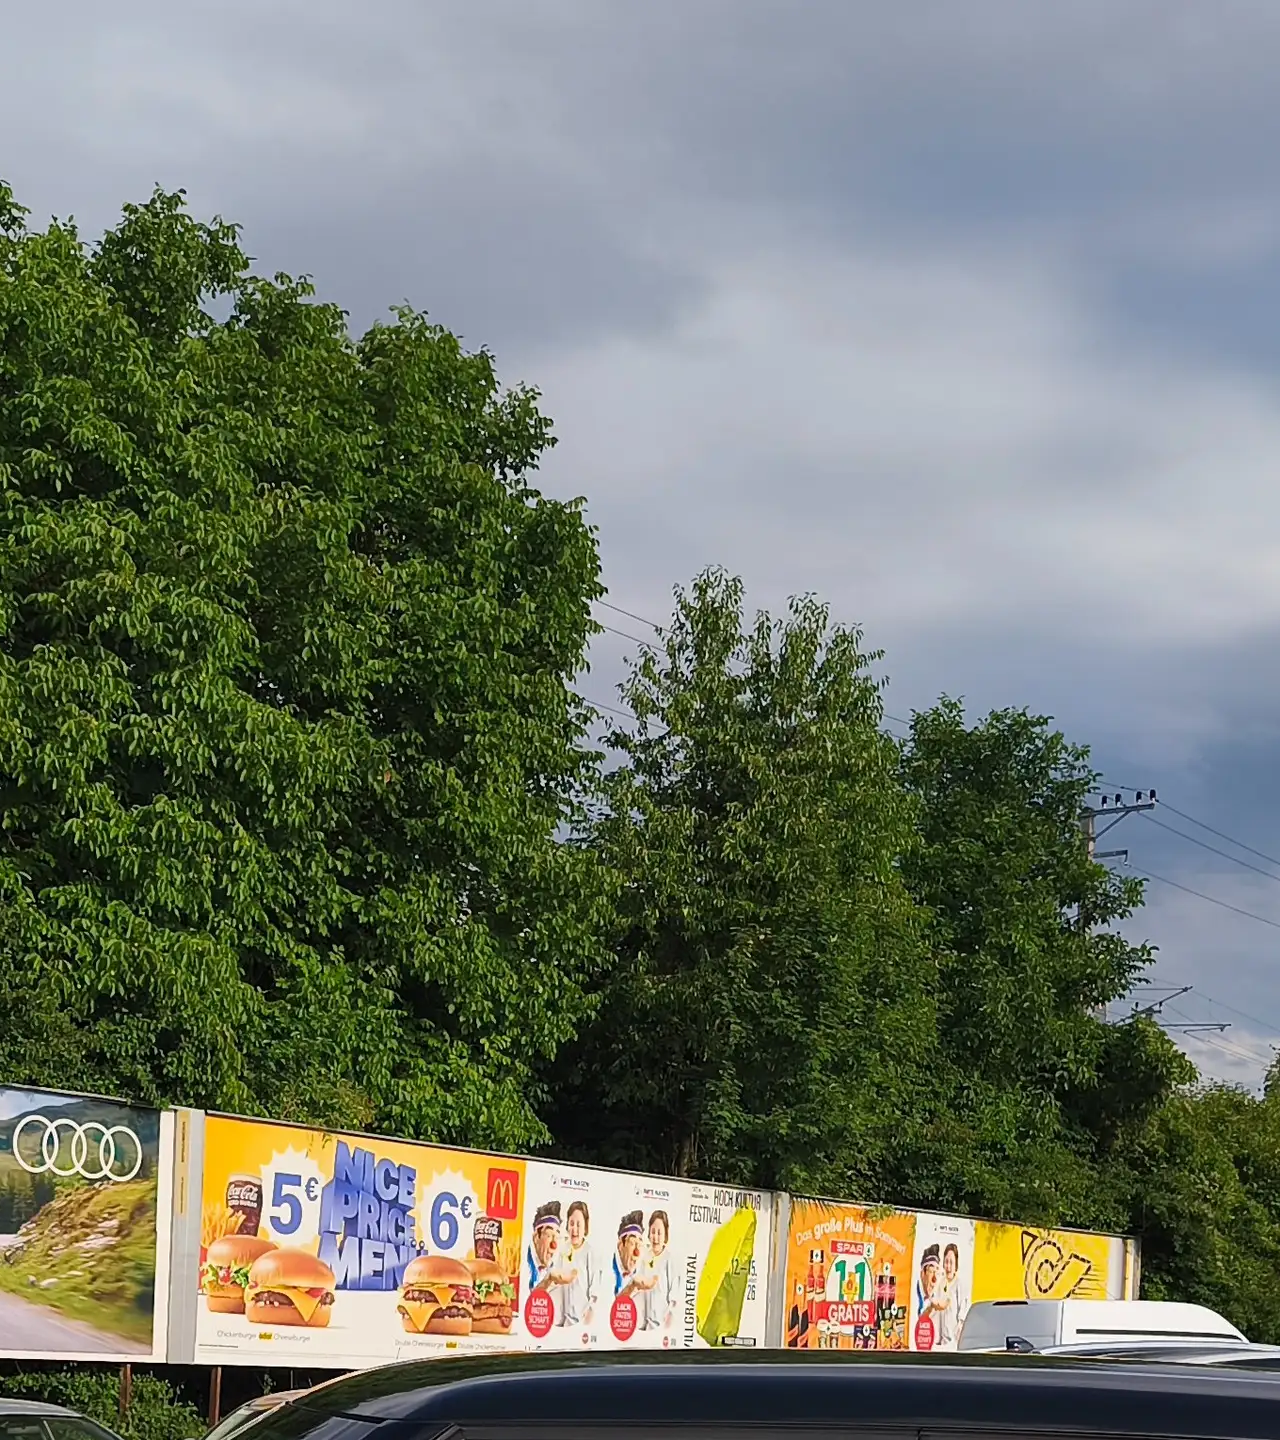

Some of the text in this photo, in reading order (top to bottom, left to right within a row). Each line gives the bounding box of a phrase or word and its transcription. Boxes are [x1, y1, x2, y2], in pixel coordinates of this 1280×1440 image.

[333, 1139, 418, 1208] NICE
[713, 1189, 734, 1207] HOCH
[320, 1180, 416, 1248] PRICE
[689, 1204, 722, 1225] FESTIVAL
[814, 1217, 843, 1240] große
[843, 1216, 865, 1234] Plus
[836, 1242, 863, 1254] SPAR
[828, 1304, 870, 1323] GRATIS
